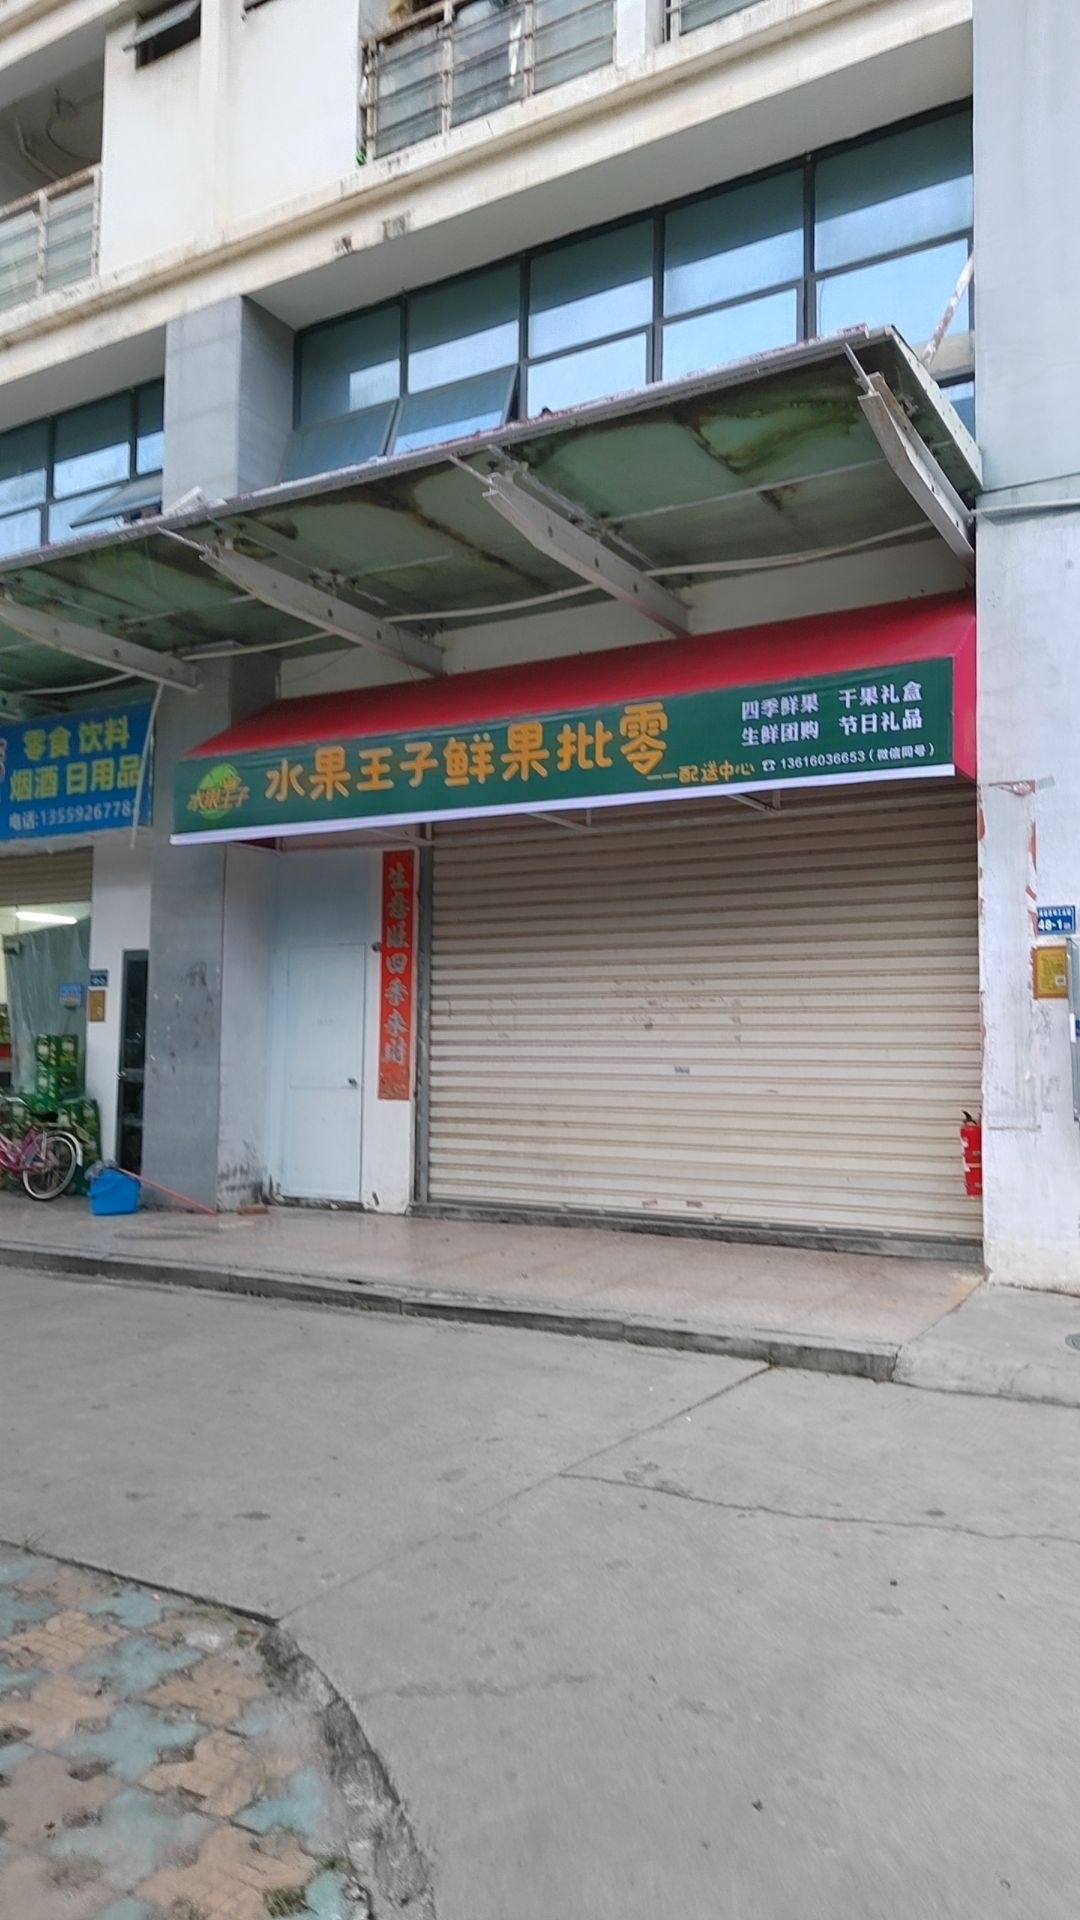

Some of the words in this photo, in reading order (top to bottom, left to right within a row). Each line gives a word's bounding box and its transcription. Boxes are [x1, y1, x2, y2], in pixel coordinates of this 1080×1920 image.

[740, 693, 819, 721] 四季鲜果
[838, 680, 923, 708] 干果礼盒
[23, 726, 72, 761] 零食
[79, 715, 130, 752] 饮料
[740, 720, 819, 747] 生鲜团购
[838, 708, 923, 736] 节日礼品
[264, 702, 669, 802] 水果王子鲜果批零
[10, 766, 59, 802] 烟酒
[66, 754, 140, 795] 日用品
